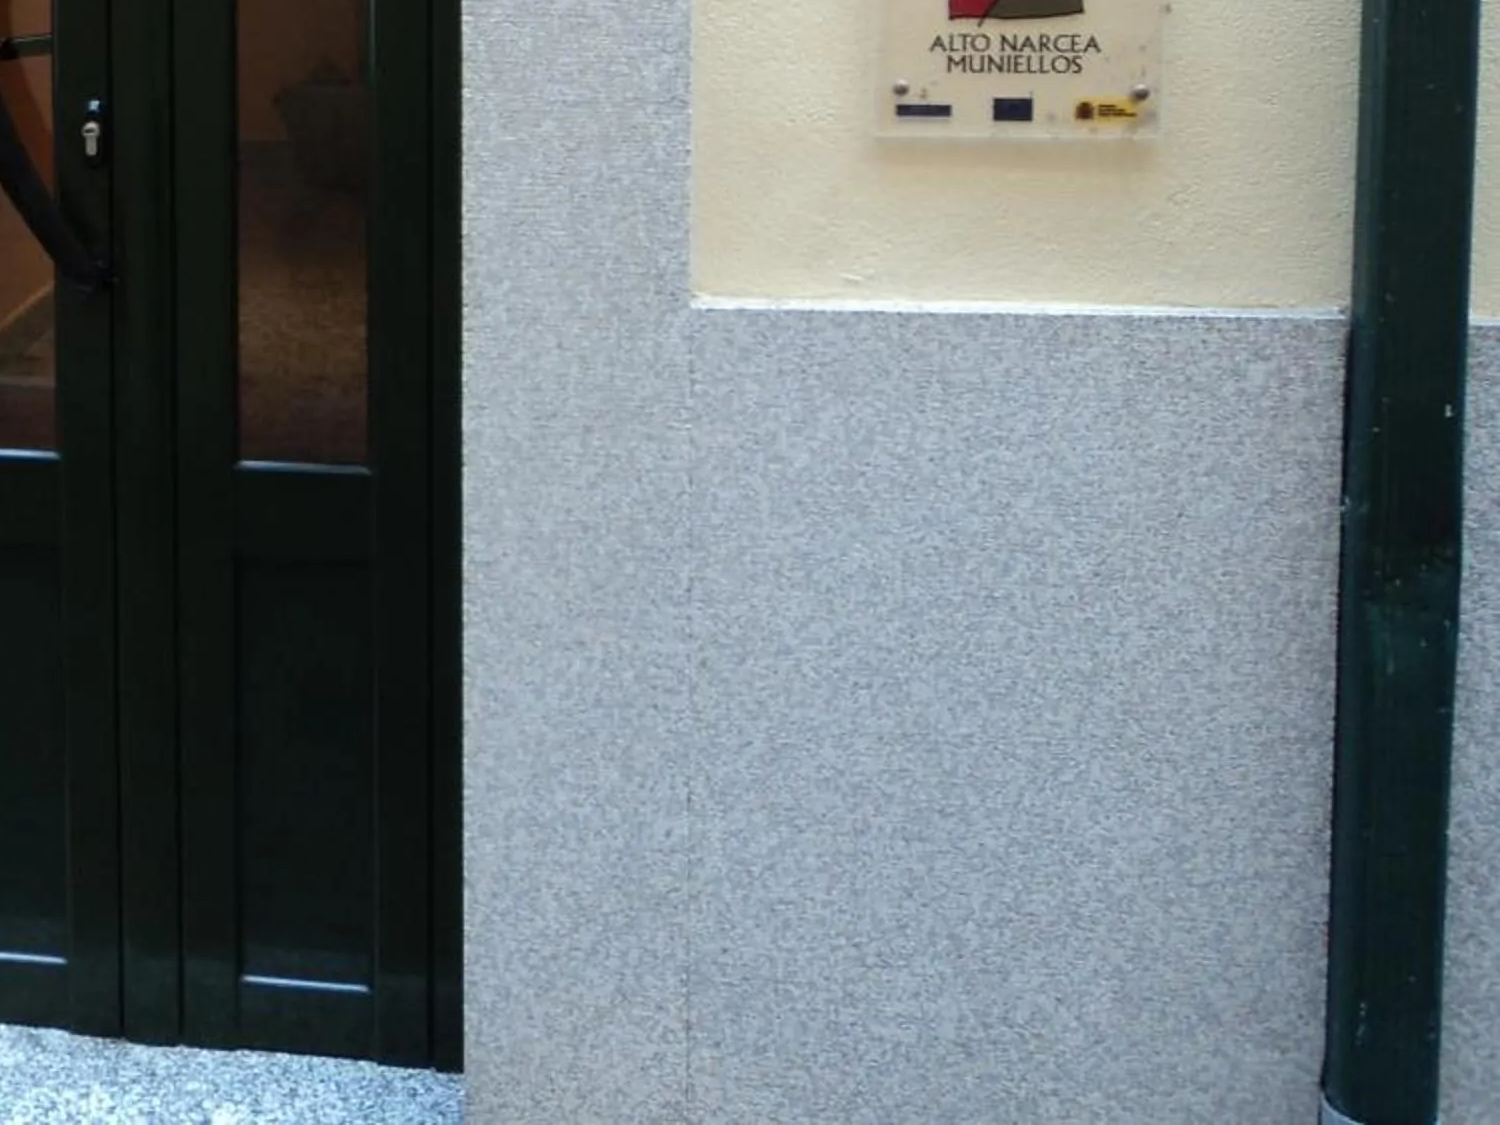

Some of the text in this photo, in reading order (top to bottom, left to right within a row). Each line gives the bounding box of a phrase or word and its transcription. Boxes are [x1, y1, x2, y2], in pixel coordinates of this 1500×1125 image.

[929, 33, 1102, 54] ALTO NARCEA
[946, 54, 1084, 74] MUNIELLOS
